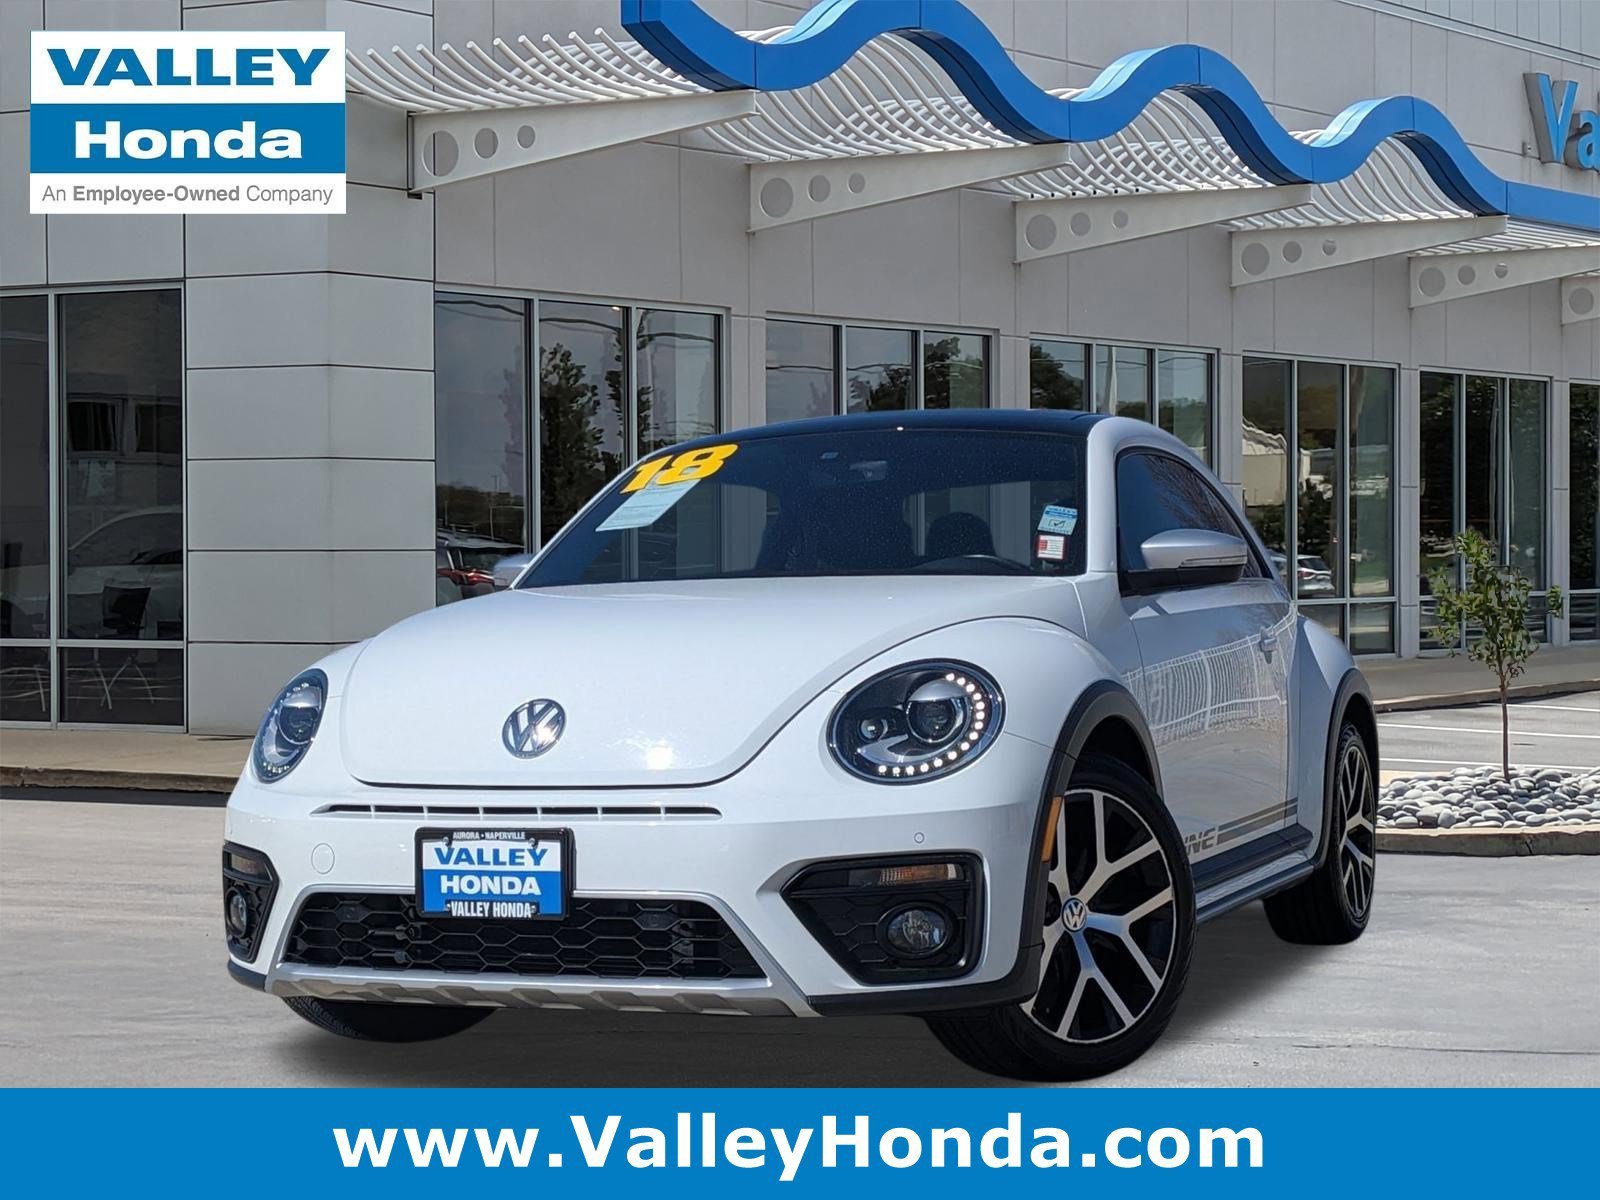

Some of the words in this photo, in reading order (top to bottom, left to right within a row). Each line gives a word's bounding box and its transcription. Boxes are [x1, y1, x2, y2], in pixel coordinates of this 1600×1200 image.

[619, 443, 739, 495] 18
[452, 831, 480, 840] AURORA
[484, 831, 526, 841] NAPERVILLE
[434, 848, 548, 866] VALLEY
[440, 874, 542, 896] HONDA
[450, 900, 490, 918] VALLEY
[492, 901, 532, 919] HONDA
